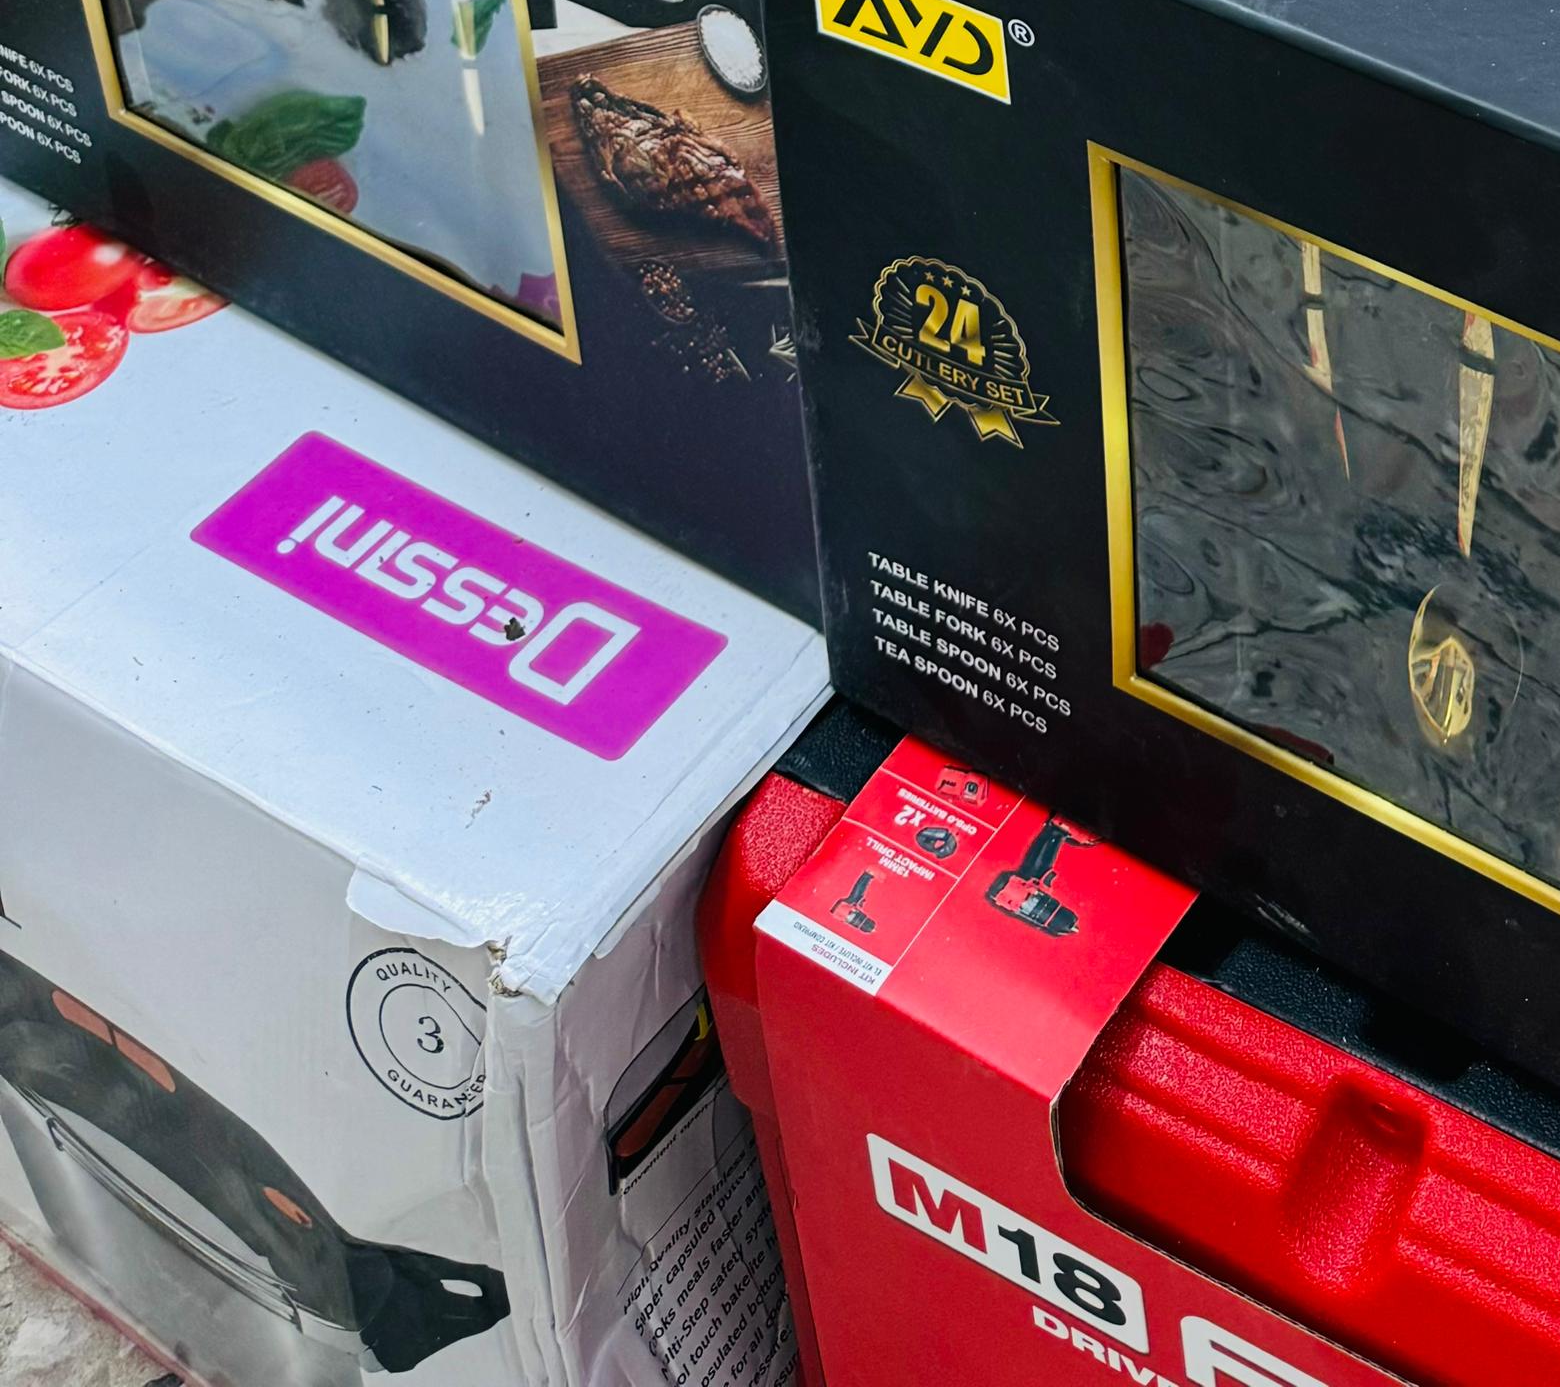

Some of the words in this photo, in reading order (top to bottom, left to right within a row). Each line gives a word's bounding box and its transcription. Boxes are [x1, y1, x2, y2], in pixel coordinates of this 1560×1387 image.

[0, 45, 29, 72] NIFE
[29, 59, 47, 79] 6X
[47, 70, 75, 94] PCS
[32, 80, 50, 101] 6X
[50, 94, 78, 118] PCS
[0, 111, 36, 140] POON
[36, 130, 55, 151] 6X
[55, 142, 82, 165] PCS
[1, 90, 46, 124] SPOON
[47, 114, 65, 135] 6X
[66, 124, 92, 148] PCS
[915, 283, 986, 366] 24
[882, 335, 980, 391] CUTLERY
[986, 380, 1024, 406] SET
[277, 494, 641, 706] Dessini
[868, 551, 929, 590] TABLE
[933, 580, 990, 618] KNIFE
[993, 608, 1017, 631] 6X
[1021, 621, 1060, 652] PCS
[870, 579, 931, 619] TABLE
[935, 608, 987, 646] FORK
[991, 636, 1015, 660] 6X
[1018, 649, 1057, 680] PCS
[872, 607, 932, 647] TABLE
[936, 637, 1001, 681] SPOON
[1005, 672, 1029, 695] 6X
[1033, 685, 1071, 717] PCS
[874, 635, 912, 665] TEA
[914, 654, 979, 699] SPOON
[982, 689, 1006, 714] 6X
[1010, 702, 1048, 734] PCS
[896, 787, 949, 821] BATTERIES
[865, 836, 897, 858] DRILL
[895, 853, 936, 881] IMPACT
[376, 961, 452, 993] QUALITY
[811, 943, 860, 977] INCLUDES
[858, 968, 876, 986] KIT
[416, 1015, 445, 1055] 3
[666, 1209, 717, 1285] capsuled
[677, 1256, 711, 1308] meals
[710, 1206, 744, 1256] faster
[745, 1177, 767, 1209] and
[711, 1245, 744, 1298] safety
[746, 1205, 774, 1247] syste
[887, 1173, 1128, 1328] M18
[690, 1314, 723, 1365] touch
[722, 1247, 767, 1314] bakelite
[731, 1351, 751, 1386] for
[749, 1327, 765, 1355] all
[764, 1289, 790, 1328] cook
[701, 1315, 750, 1387] psulated
[749, 1322, 793, 1387] ressure:
